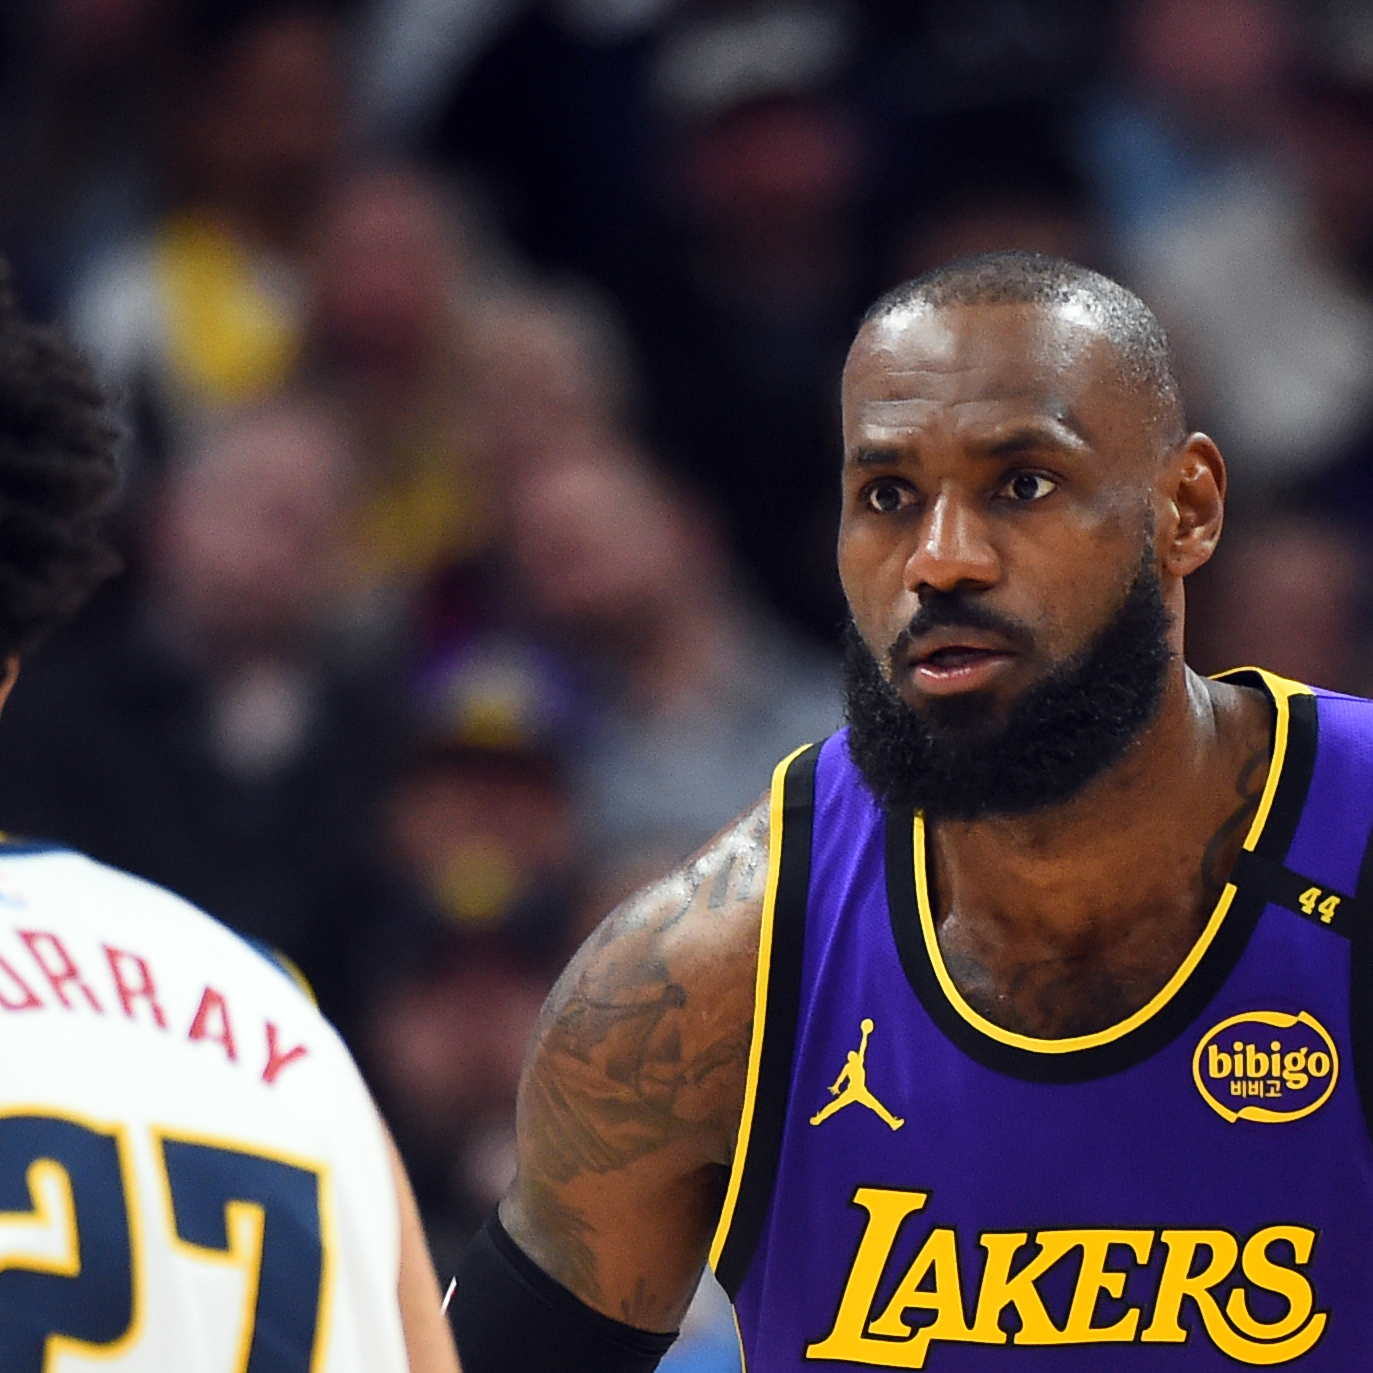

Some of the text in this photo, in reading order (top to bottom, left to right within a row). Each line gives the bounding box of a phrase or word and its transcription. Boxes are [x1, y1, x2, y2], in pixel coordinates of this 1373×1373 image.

[1298, 886, 1341, 924] 44
[1208, 1041, 1330, 1089] bibigo
[1230, 1080, 1283, 1098] 비비고
[805, 1186, 1327, 1367] LAKERS
